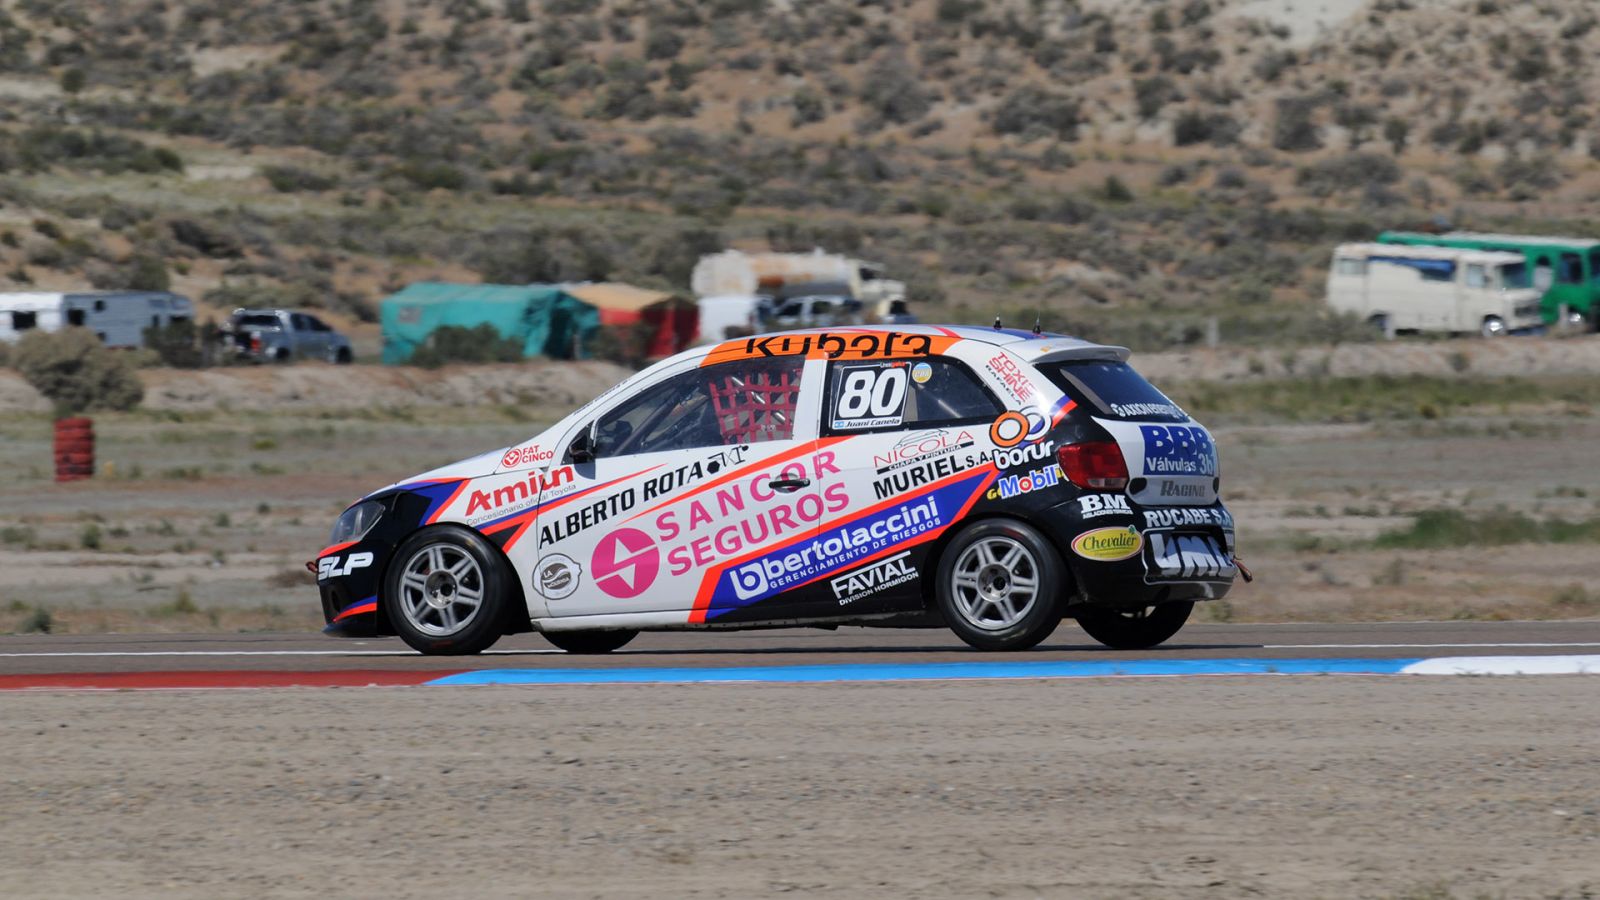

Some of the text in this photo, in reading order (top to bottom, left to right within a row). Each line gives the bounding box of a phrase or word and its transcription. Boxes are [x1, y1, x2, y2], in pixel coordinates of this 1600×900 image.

[838, 368, 907, 418] 80
[985, 364, 1022, 406] RAFAELA
[988, 357, 1033, 403] SHINE
[846, 418, 900, 428] Juani Canela
[521, 450, 554, 464] CINCO
[522, 444, 540, 455] FAT
[873, 430, 974, 468] NICOLA
[888, 458, 915, 470] CHAPA
[925, 445, 961, 459] PINTURA
[993, 440, 1054, 469] borur
[1146, 456, 1197, 472] Válvulas
[465, 466, 574, 517] Amiun
[873, 451, 993, 500] MURIEL S.A.
[998, 464, 1059, 499] Mobil
[466, 503, 524, 526] Concesionario
[550, 484, 577, 499] Toyota
[539, 461, 704, 550] ALBERTO ROTA
[655, 450, 841, 542] SANCOR
[1077, 493, 1131, 514] BM
[667, 482, 850, 576] SEGUROS
[1142, 508, 1212, 528] RUCABE
[762, 495, 939, 580] bertolaccini
[769, 517, 941, 589] GERENCIAMIENTO DE RIESGOS
[1082, 532, 1137, 551] Chevalier
[318, 551, 374, 581] SLP
[543, 570, 553, 578] LA
[830, 550, 916, 599] FAVIAL
[839, 572, 919, 606] DIVISION HORMIGON
